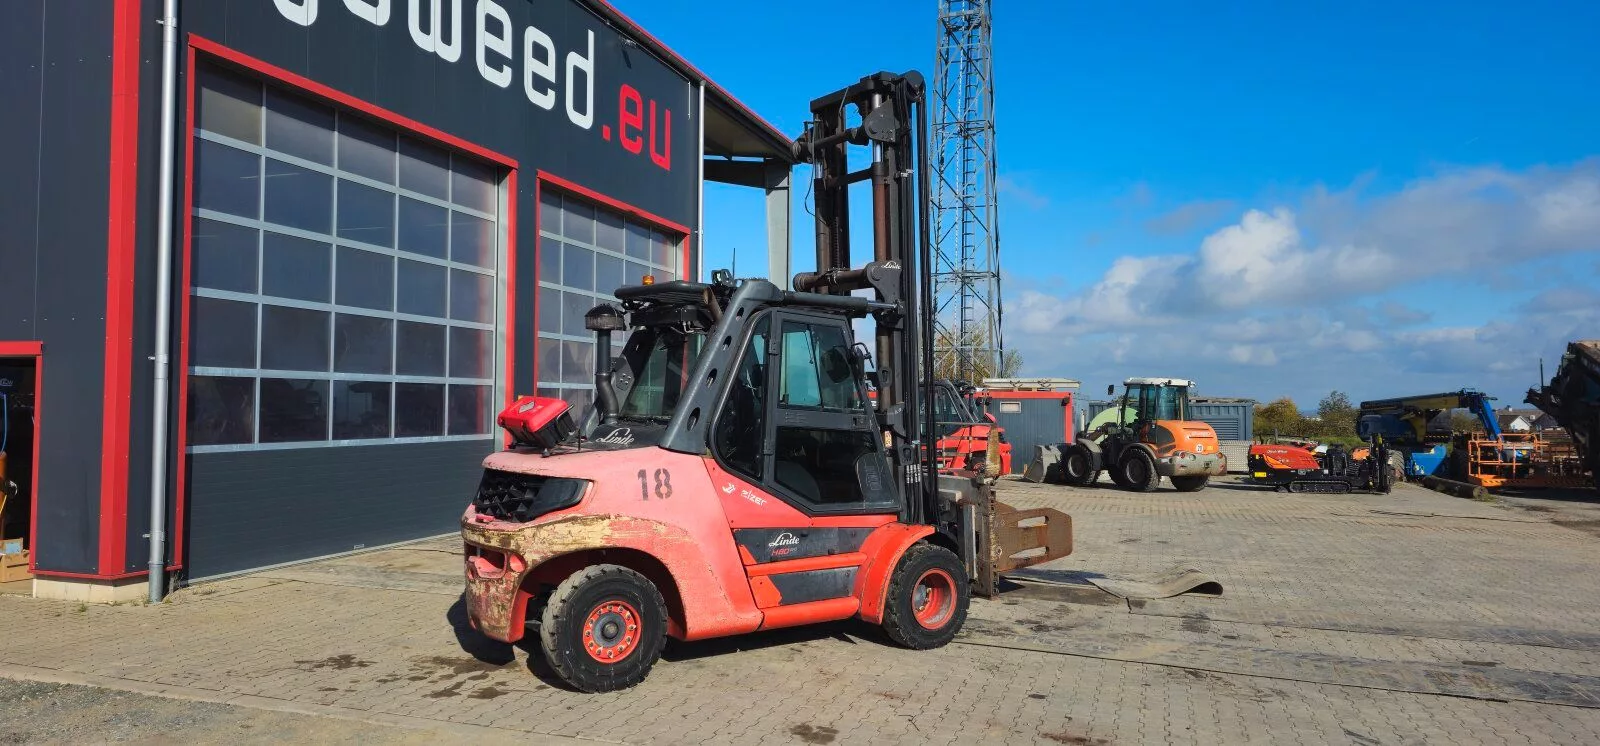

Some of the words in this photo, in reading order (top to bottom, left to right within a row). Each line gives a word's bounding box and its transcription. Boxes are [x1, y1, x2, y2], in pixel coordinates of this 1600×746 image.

[272, 0, 671, 171] weed.eu
[595, 427, 635, 445] Linde
[637, 468, 673, 501] 18
[768, 532, 800, 547] Linde
